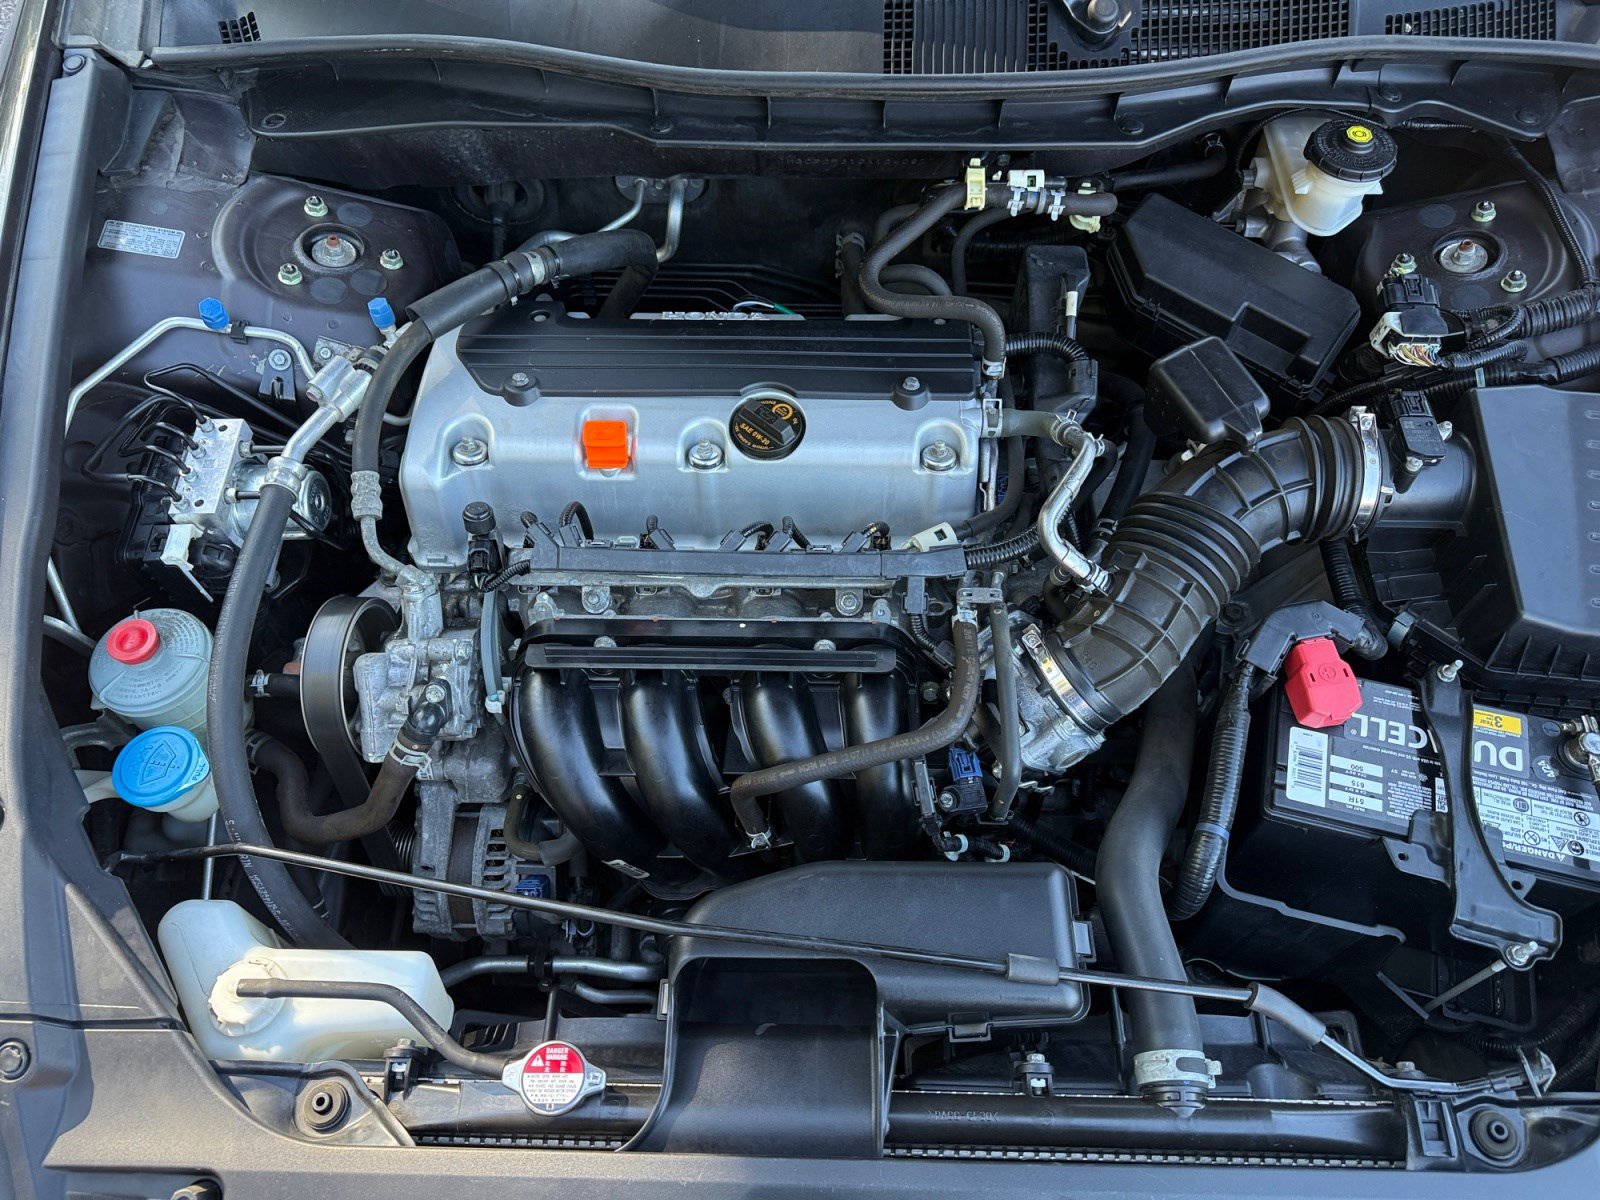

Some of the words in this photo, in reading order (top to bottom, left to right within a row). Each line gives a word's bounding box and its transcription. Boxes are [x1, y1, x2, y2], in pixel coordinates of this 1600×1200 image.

[740, 423, 754, 434] SAE
[752, 432, 770, 446] 0W-20
[1494, 716, 1503, 728] 3
[1352, 712, 1522, 771] DUCELL
[192, 763, 206, 780] PULL
[1348, 796, 1364, 804] 51R
